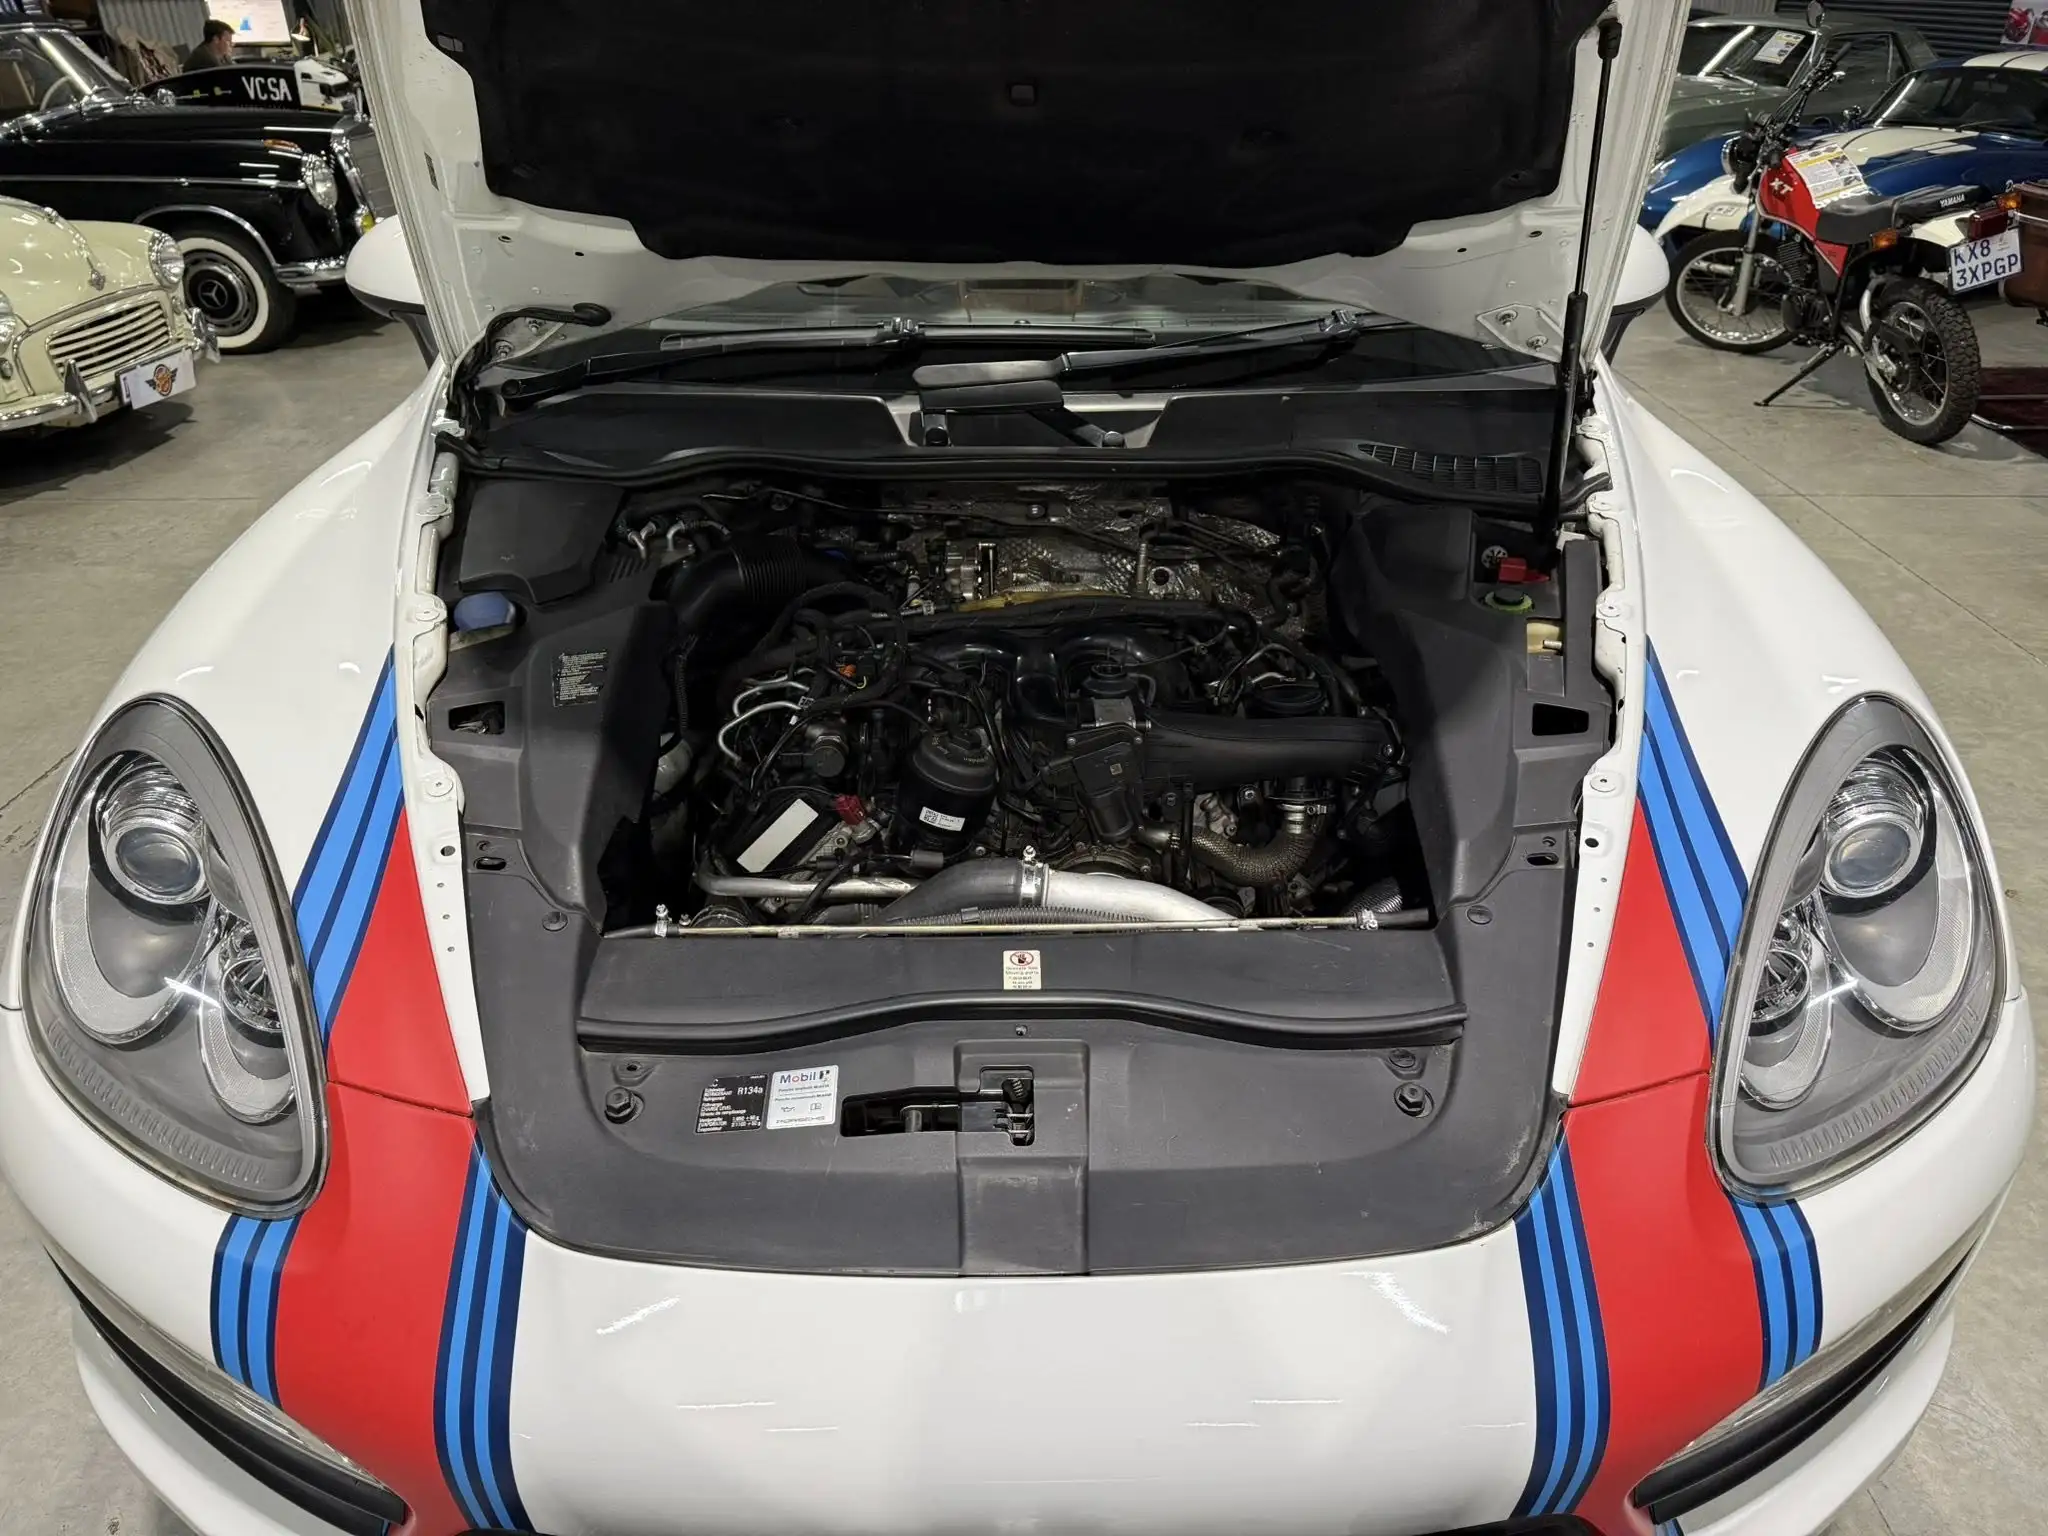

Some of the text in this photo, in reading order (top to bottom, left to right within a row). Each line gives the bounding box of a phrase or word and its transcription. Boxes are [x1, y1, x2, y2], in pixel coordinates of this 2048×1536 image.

[241, 76, 293, 101] VCSA
[1769, 177, 1794, 195] XT
[1940, 193, 1965, 208] YAMAHA
[1954, 239, 1991, 266] KX8
[1956, 253, 2019, 288] 3XPGP
[780, 1071, 816, 1084] Mobil
[737, 1086, 764, 1095] R134a
